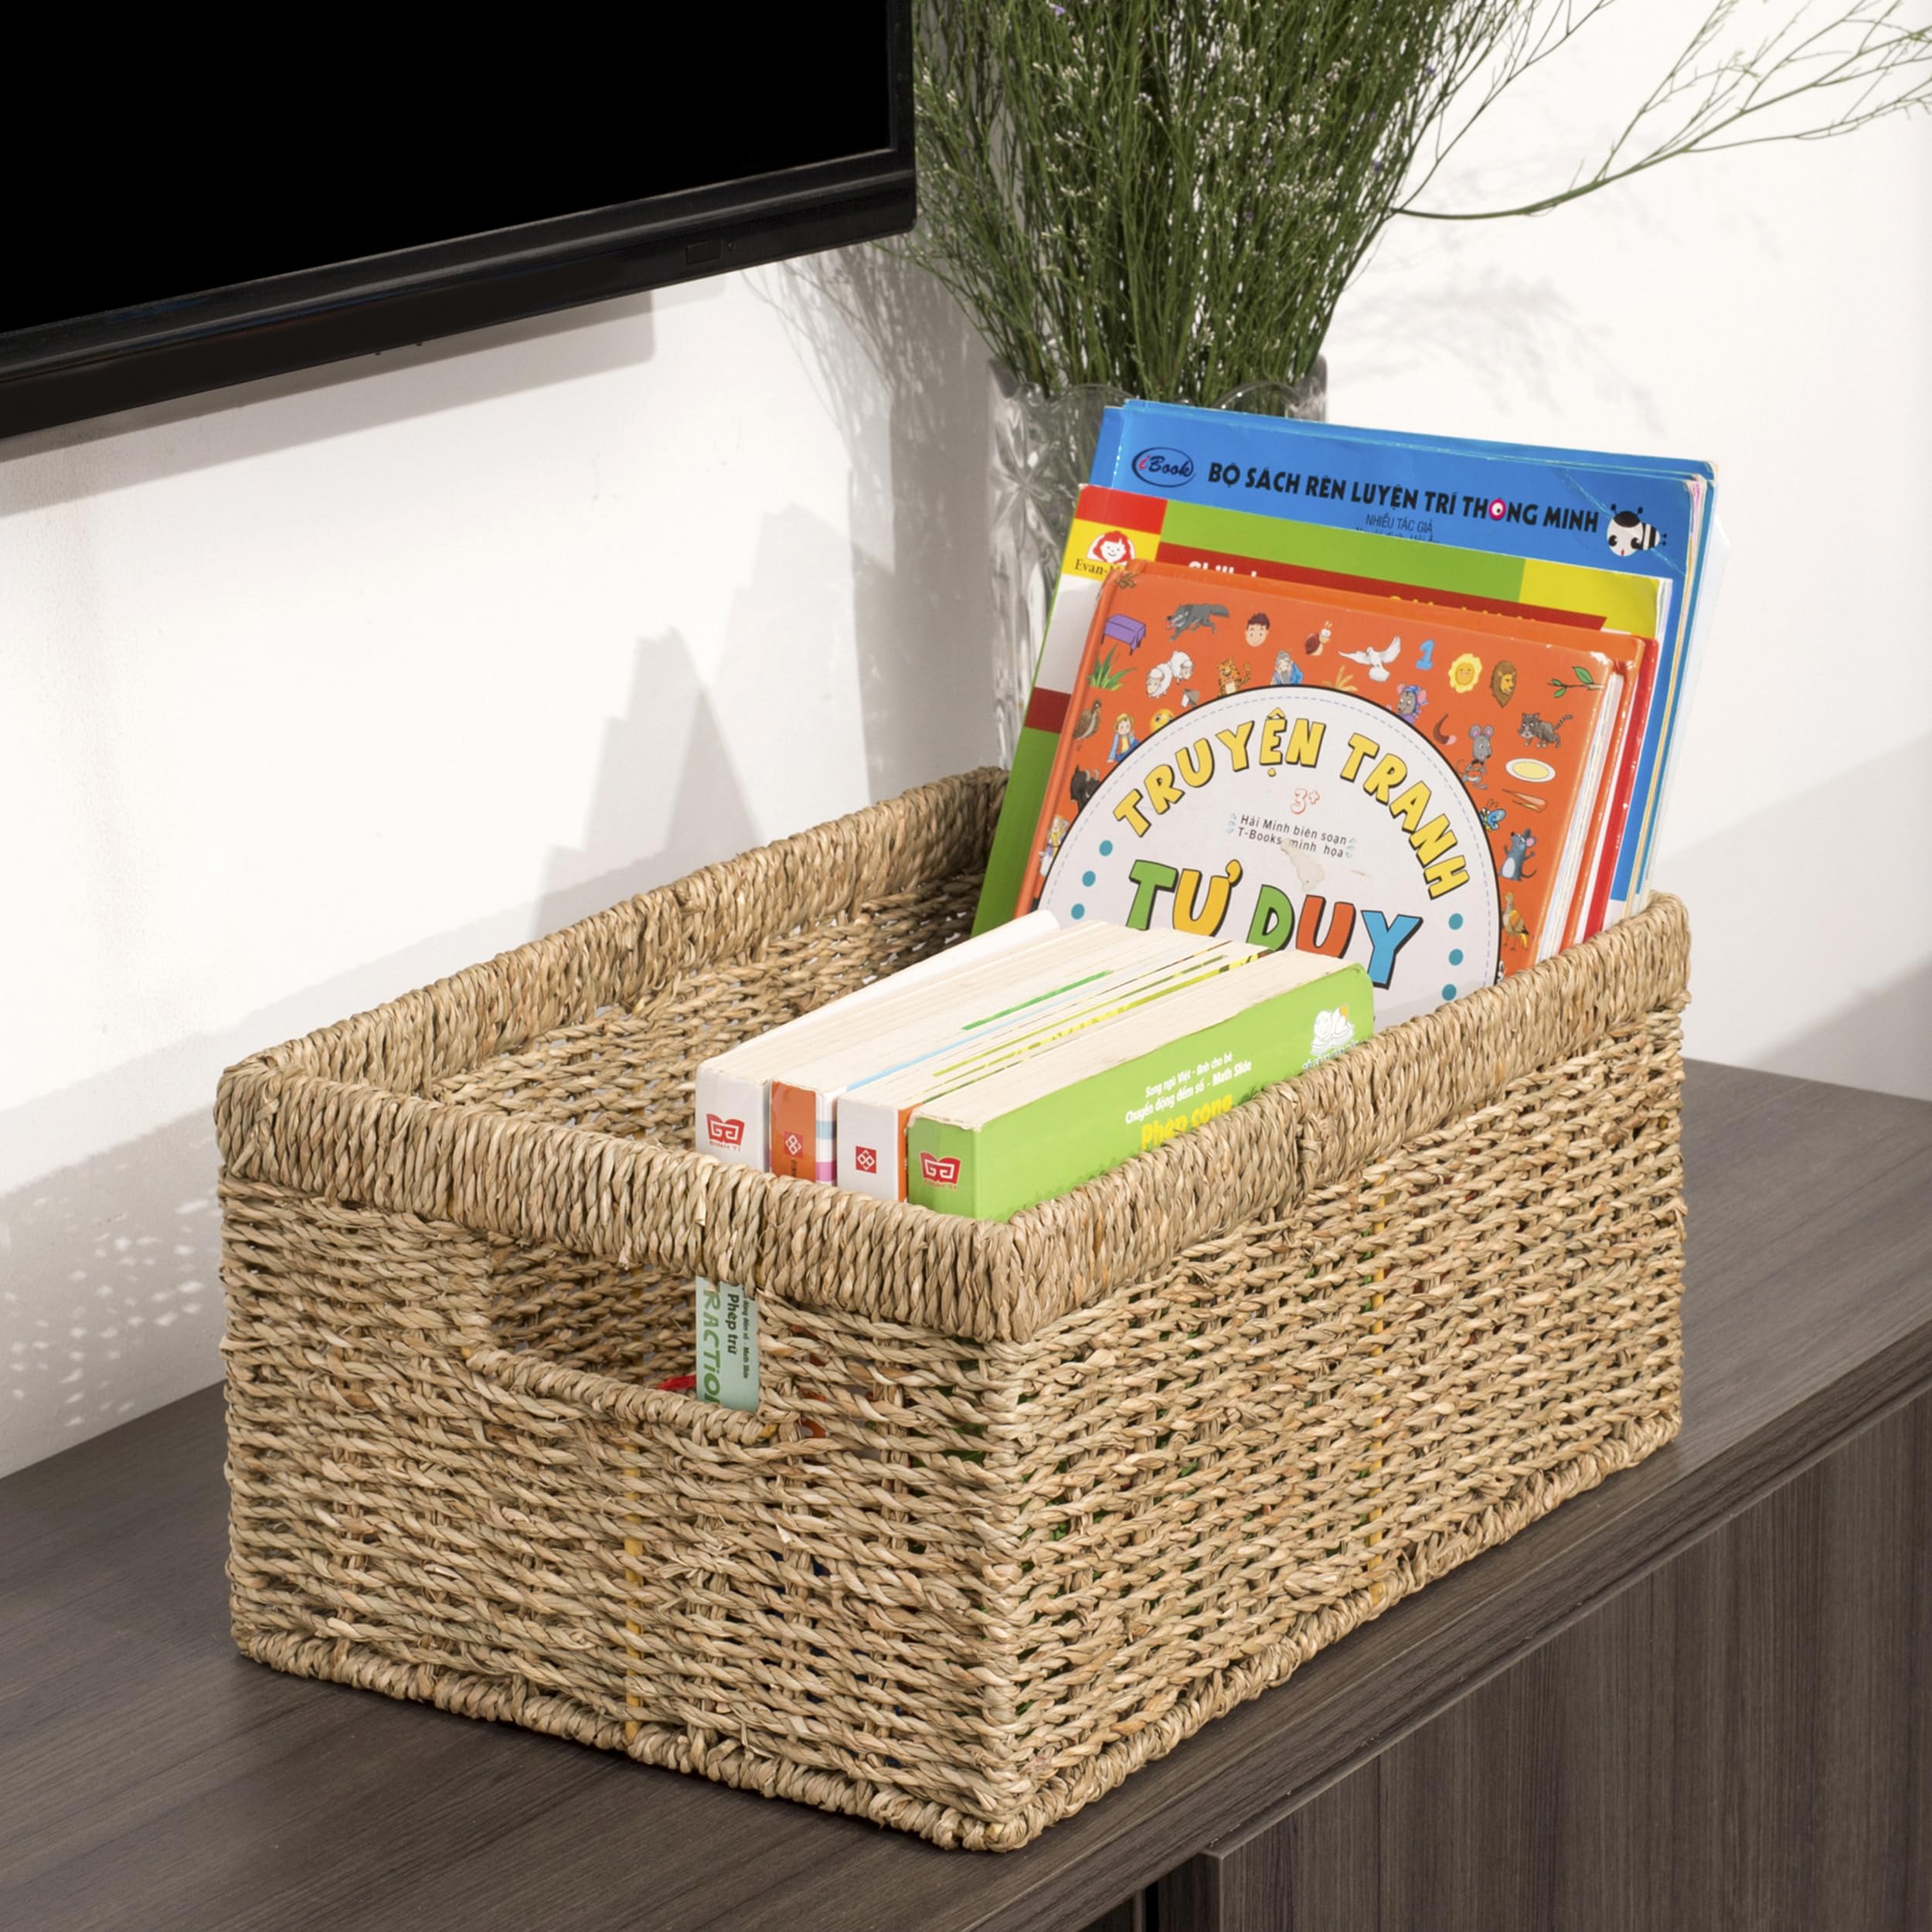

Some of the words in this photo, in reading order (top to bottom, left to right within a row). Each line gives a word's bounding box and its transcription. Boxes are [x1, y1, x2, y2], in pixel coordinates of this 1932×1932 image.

[1208, 461, 1240, 488] BỘ
[1245, 466, 1301, 495] SÁCH
[1351, 481, 1419, 511] LUYỆN
[1424, 490, 1458, 515] TRÍ
[1543, 505, 1599, 532] MINH
[1397, 516, 1415, 532] TÁC
[1113, 707, 1327, 838] TRUYỆN
[1339, 733, 1471, 900] TRANH
[1238, 827, 1282, 845] T-Books
[1290, 838, 1317, 852] minh
[1263, 819, 1290, 833] Minh
[1294, 825, 1318, 838] biên
[1125, 859, 1243, 937] TƯ
[1246, 883, 1423, 990] DUY
[725, 1294, 740, 1330] Phép
